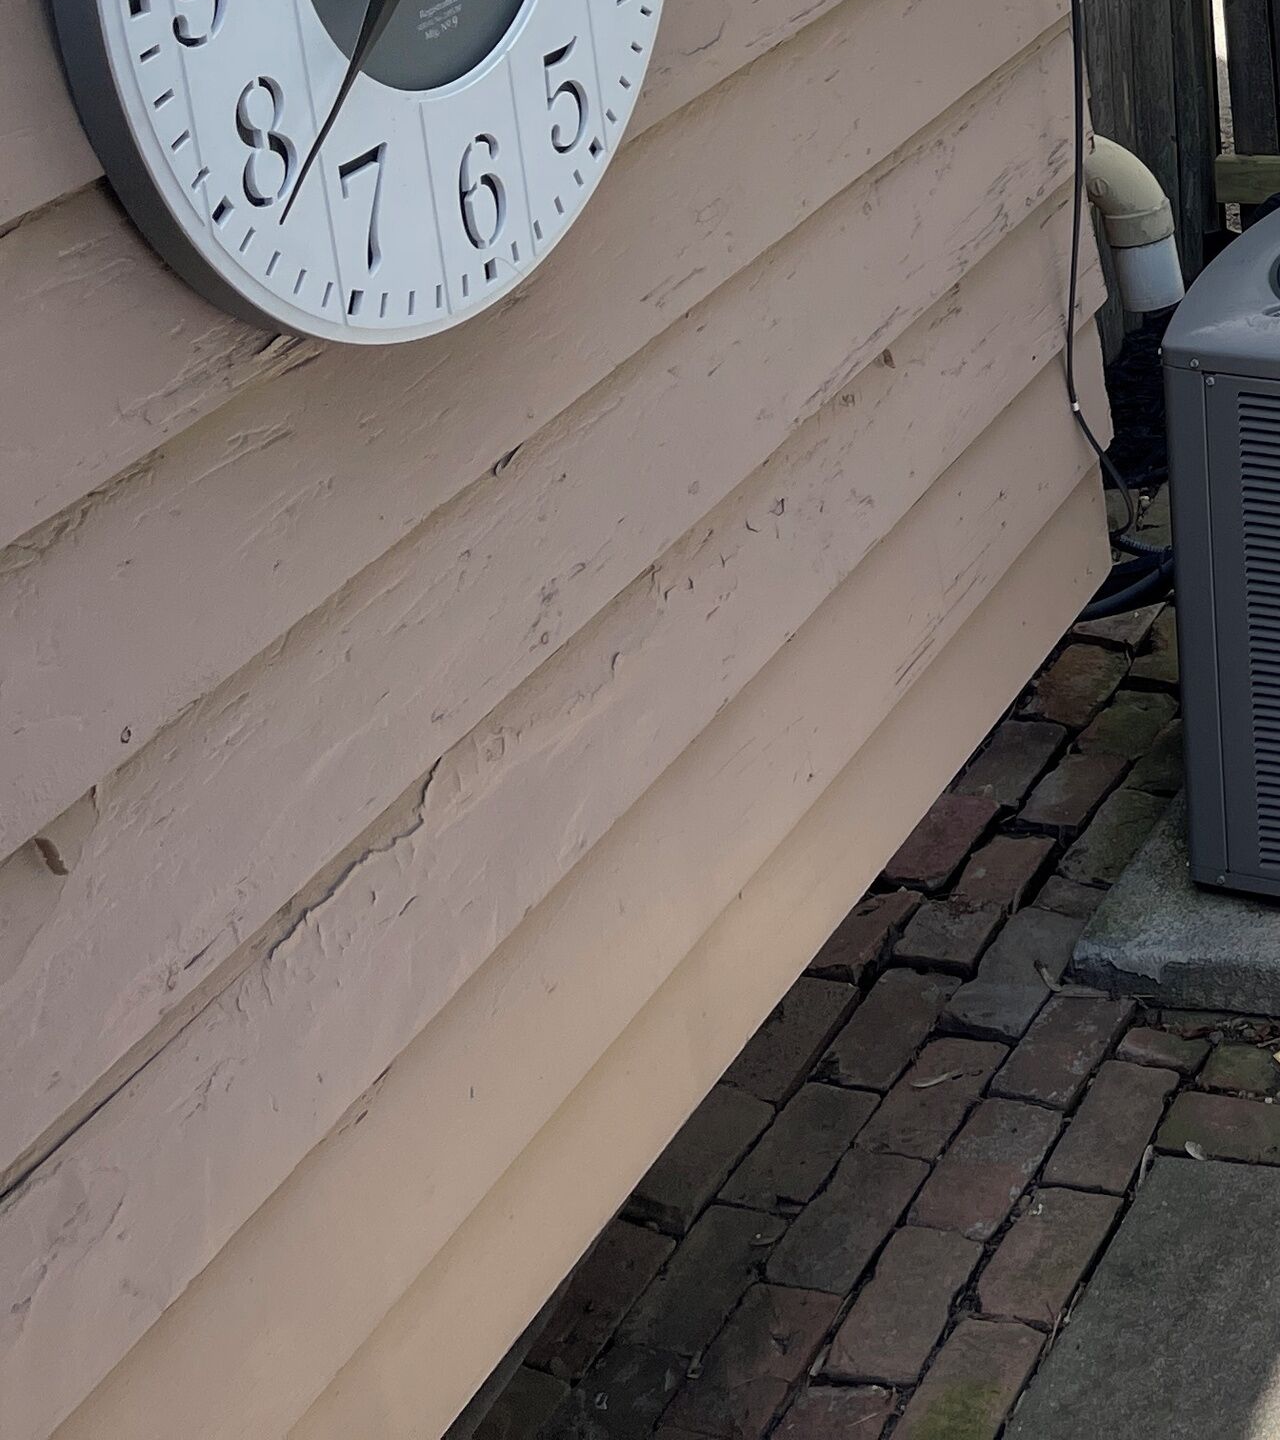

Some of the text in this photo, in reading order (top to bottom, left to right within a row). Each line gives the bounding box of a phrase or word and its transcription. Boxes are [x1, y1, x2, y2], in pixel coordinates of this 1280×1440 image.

[236, 77, 293, 207] 8
[544, 36, 590, 155] 5
[340, 142, 388, 275] 7
[459, 133, 507, 249] 6
